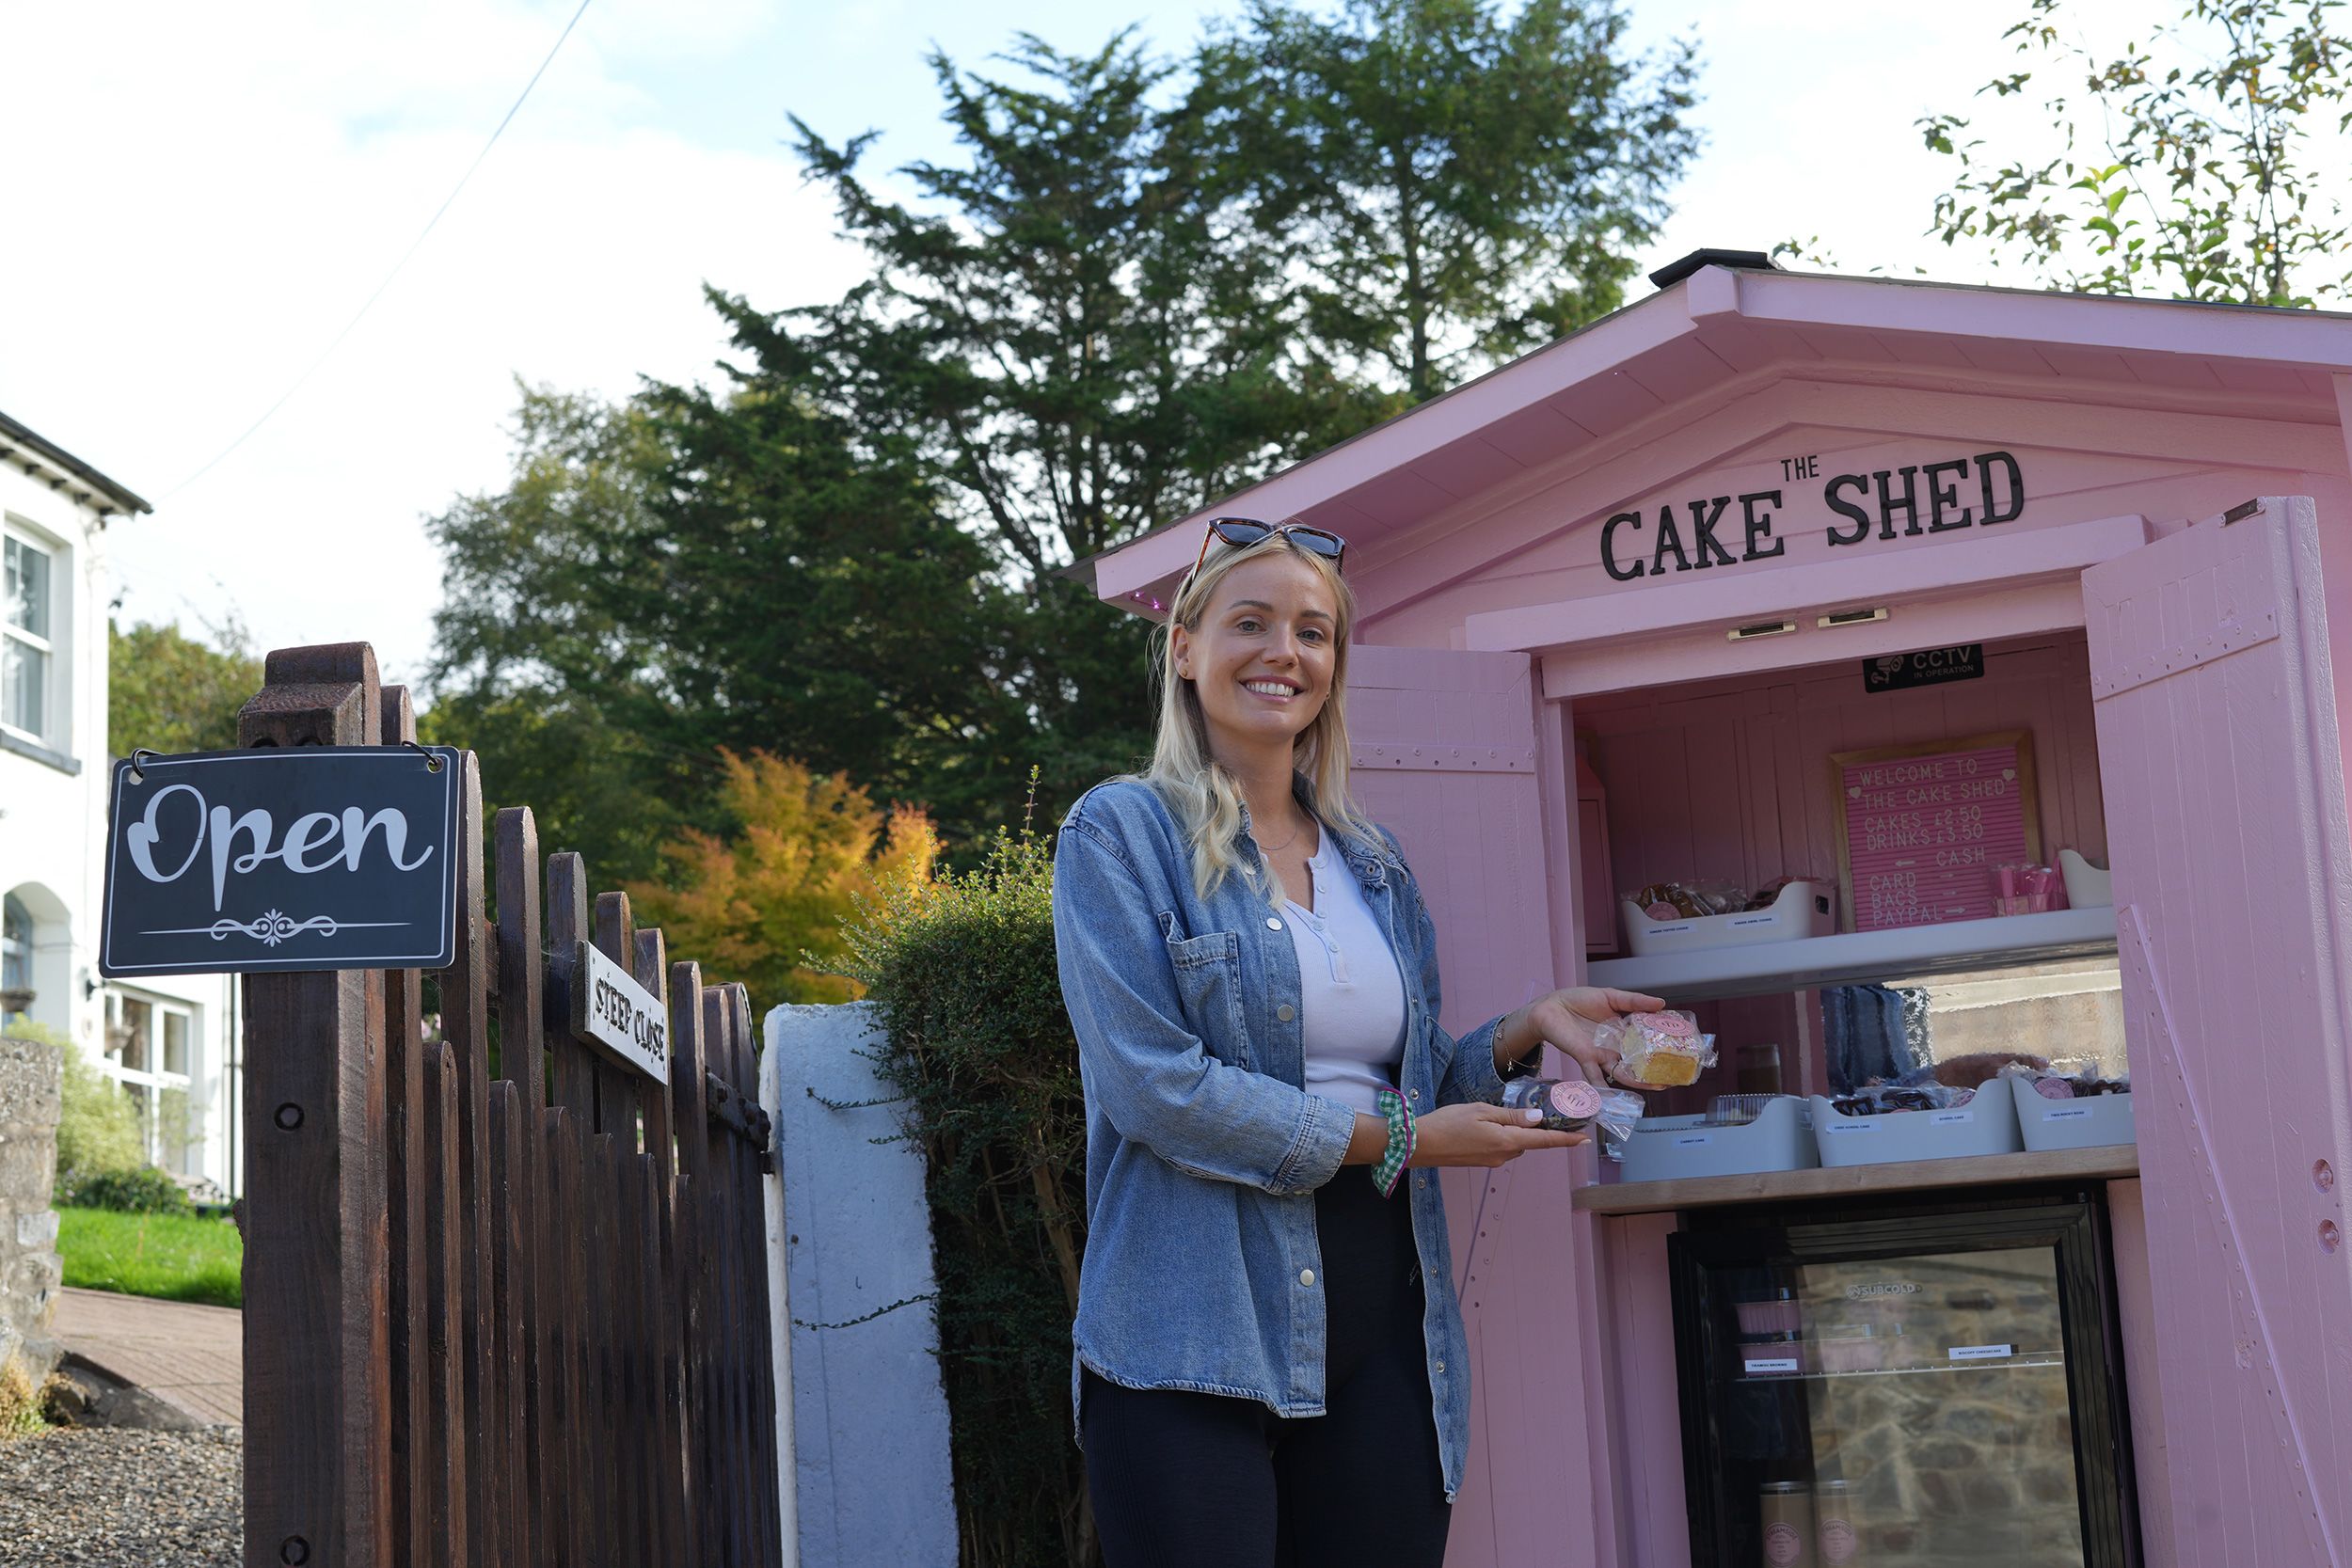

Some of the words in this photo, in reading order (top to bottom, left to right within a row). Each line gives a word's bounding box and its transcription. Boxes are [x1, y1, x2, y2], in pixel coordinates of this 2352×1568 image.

[1780, 455, 1820, 482] THE
[1599, 489, 1786, 581] CAKE
[1823, 451, 2025, 546] SHED
[1913, 646, 1972, 669] CCTV
[1925, 664, 1974, 678] OPERATION
[1859, 763, 1944, 786] WELCOME
[1955, 758, 1978, 776] TO
[1863, 791, 1897, 810] THE
[1906, 785, 1953, 805] CAKE
[1960, 779, 2006, 799] SHED
[1865, 813, 1922, 832] CAKES
[1934, 805, 1981, 826] £2.50
[126, 784, 435, 912] Open
[1867, 829, 1931, 851] DRINKS
[1936, 823, 1983, 844] £3.50
[1936, 846, 1985, 867] CASH
[1869, 872, 1916, 891] CARD
[1871, 889, 1918, 910] BACS
[1873, 904, 1943, 927] PAYPAL
[596, 975, 632, 1035] STEEP
[634, 1007, 664, 1062] CLOSE
